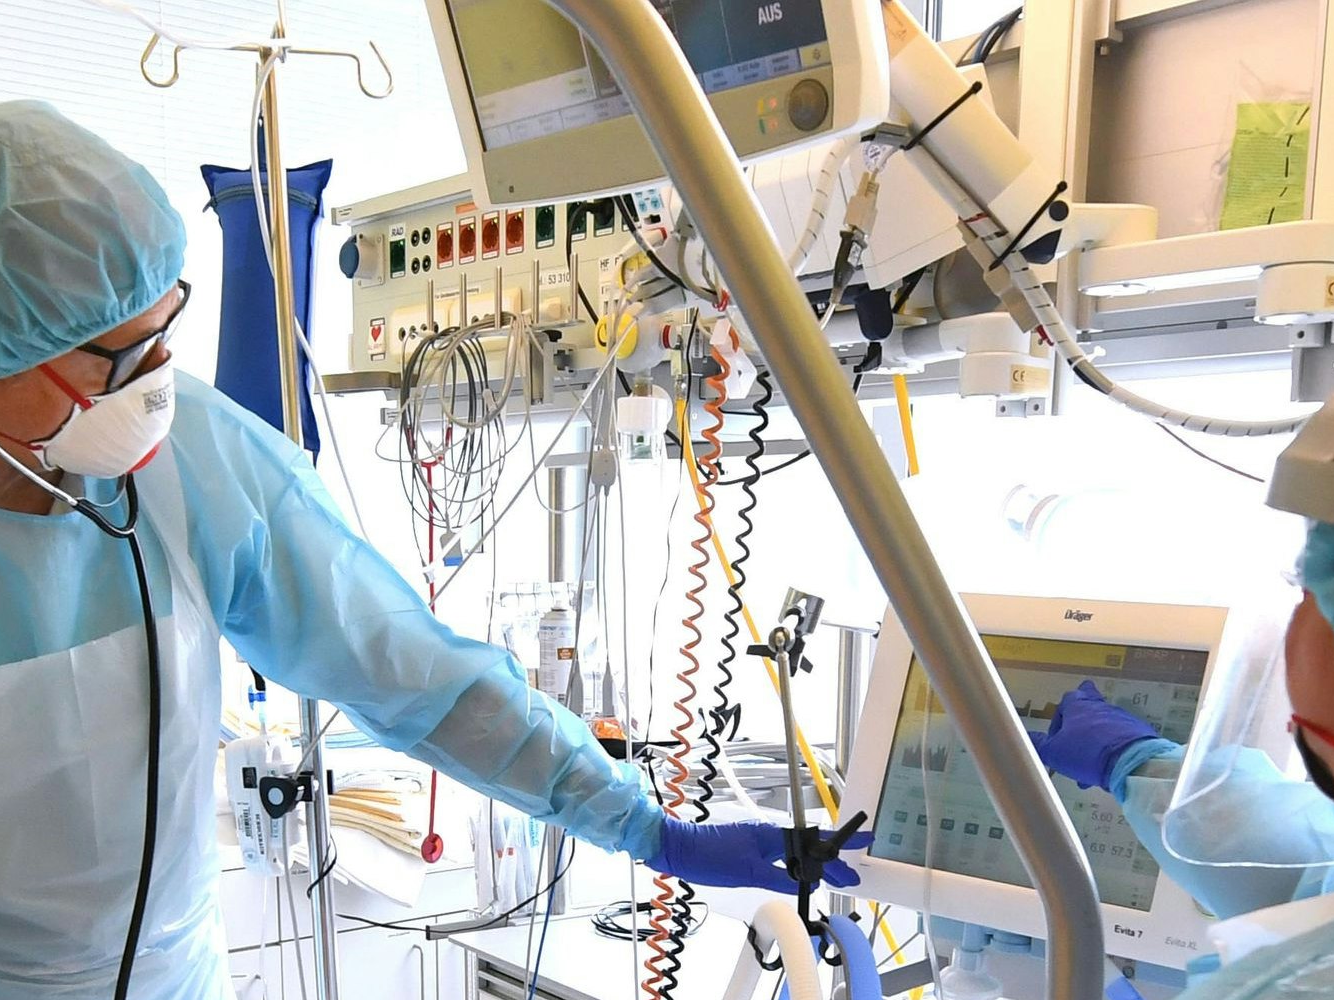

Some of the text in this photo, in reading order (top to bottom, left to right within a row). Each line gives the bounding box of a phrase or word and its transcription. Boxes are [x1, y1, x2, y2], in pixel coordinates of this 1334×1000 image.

[757, 3, 783, 26] AUS
[1064, 609, 1094, 623] Dräger
[1114, 924, 1136, 937] Evita
